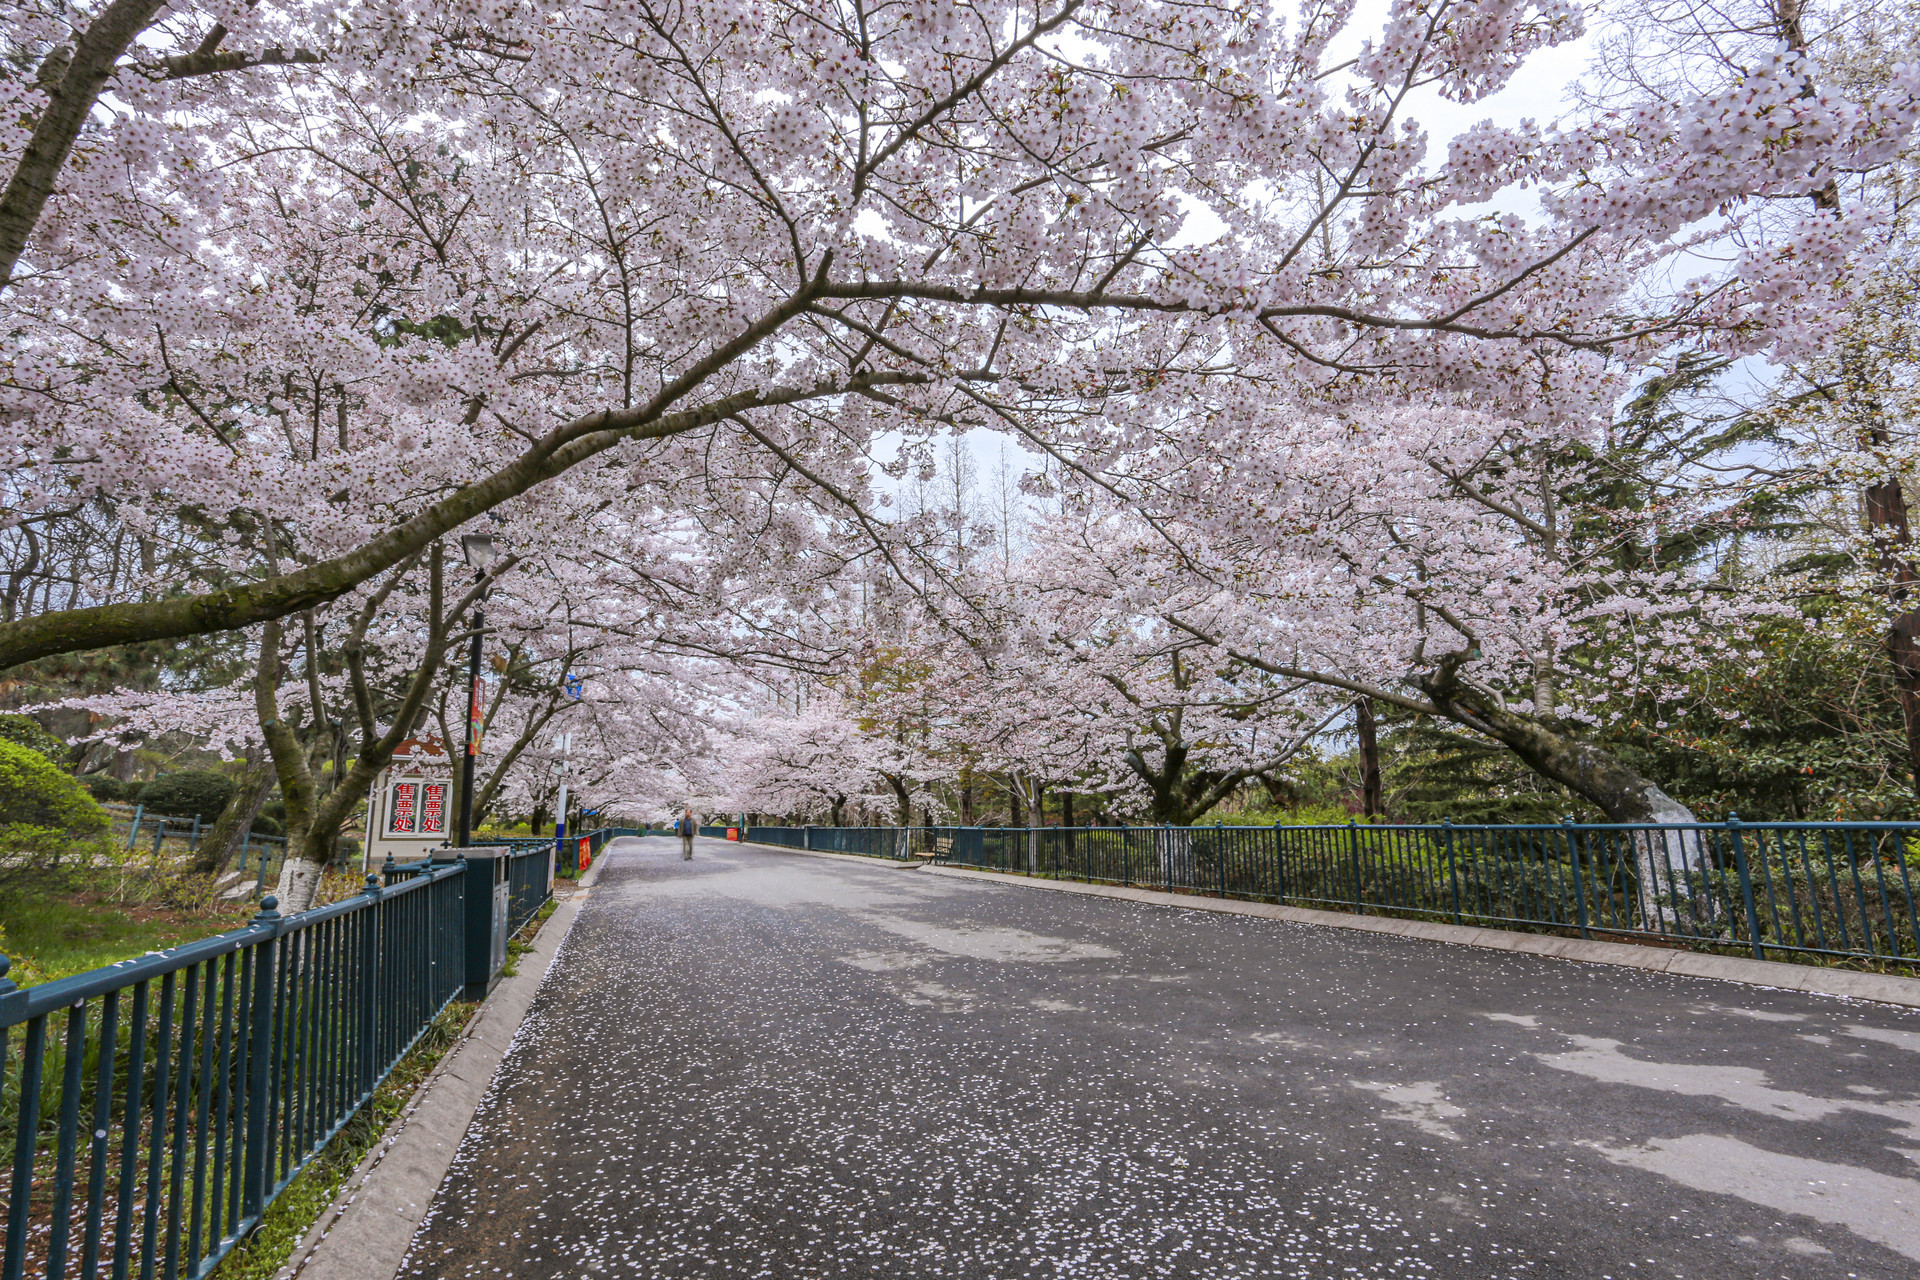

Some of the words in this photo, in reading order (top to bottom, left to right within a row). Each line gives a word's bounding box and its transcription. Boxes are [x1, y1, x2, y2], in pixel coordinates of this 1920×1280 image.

[394, 784, 415, 832] 售票处
[423, 785, 443, 832] 售票处
